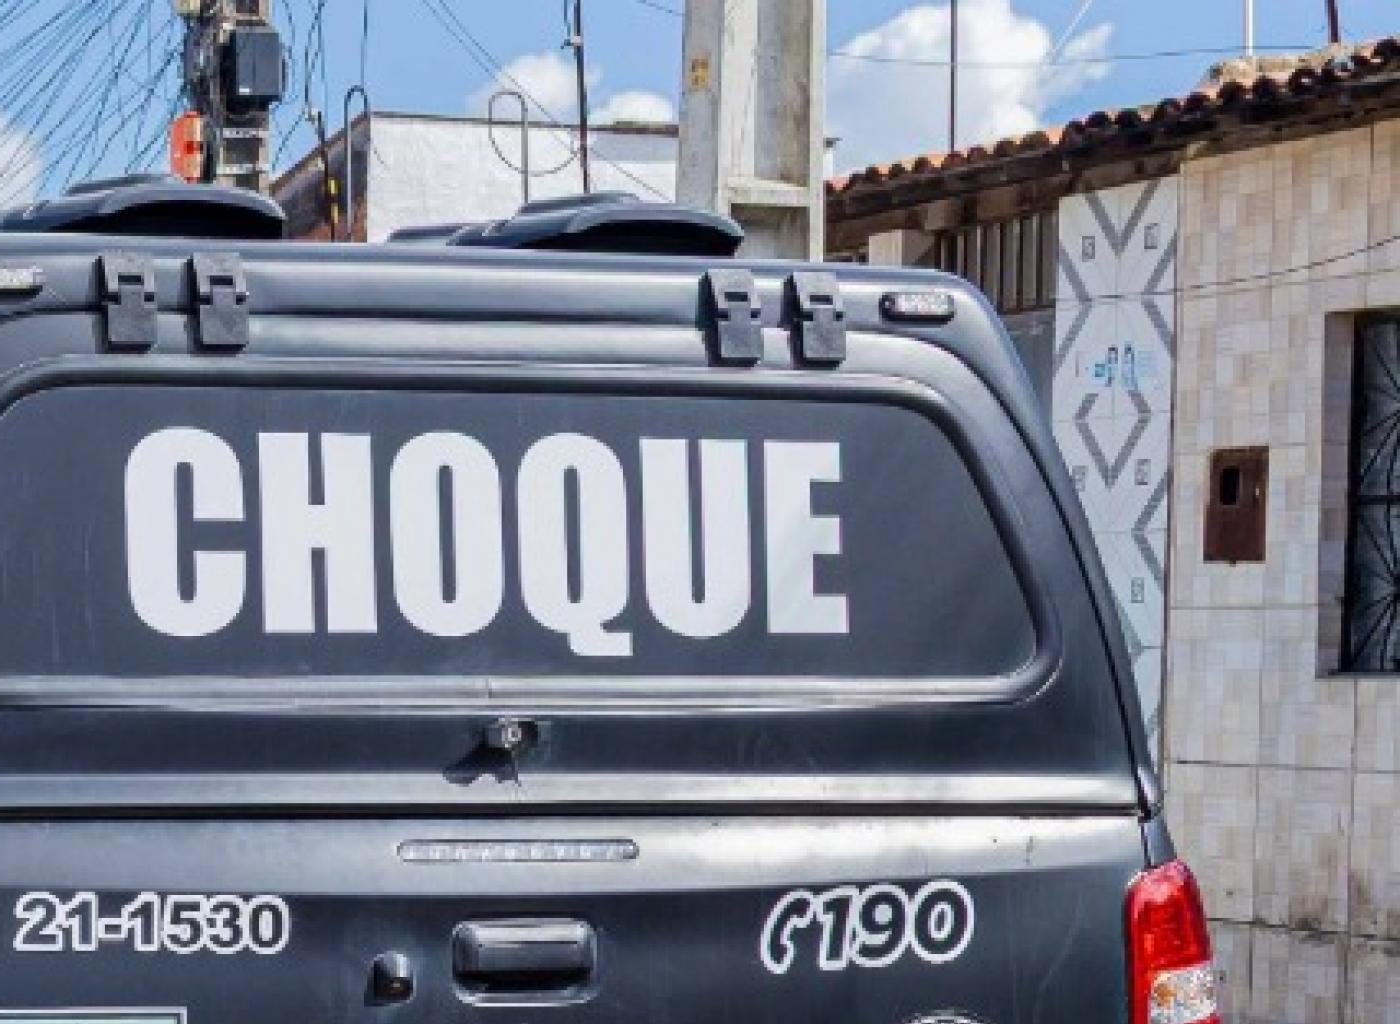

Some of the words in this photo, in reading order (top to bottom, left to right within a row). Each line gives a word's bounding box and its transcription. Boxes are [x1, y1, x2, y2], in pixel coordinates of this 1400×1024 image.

[124, 426, 850, 656] CHOQUE
[13, 891, 290, 954] 21-1530
[816, 880, 975, 971] 190
